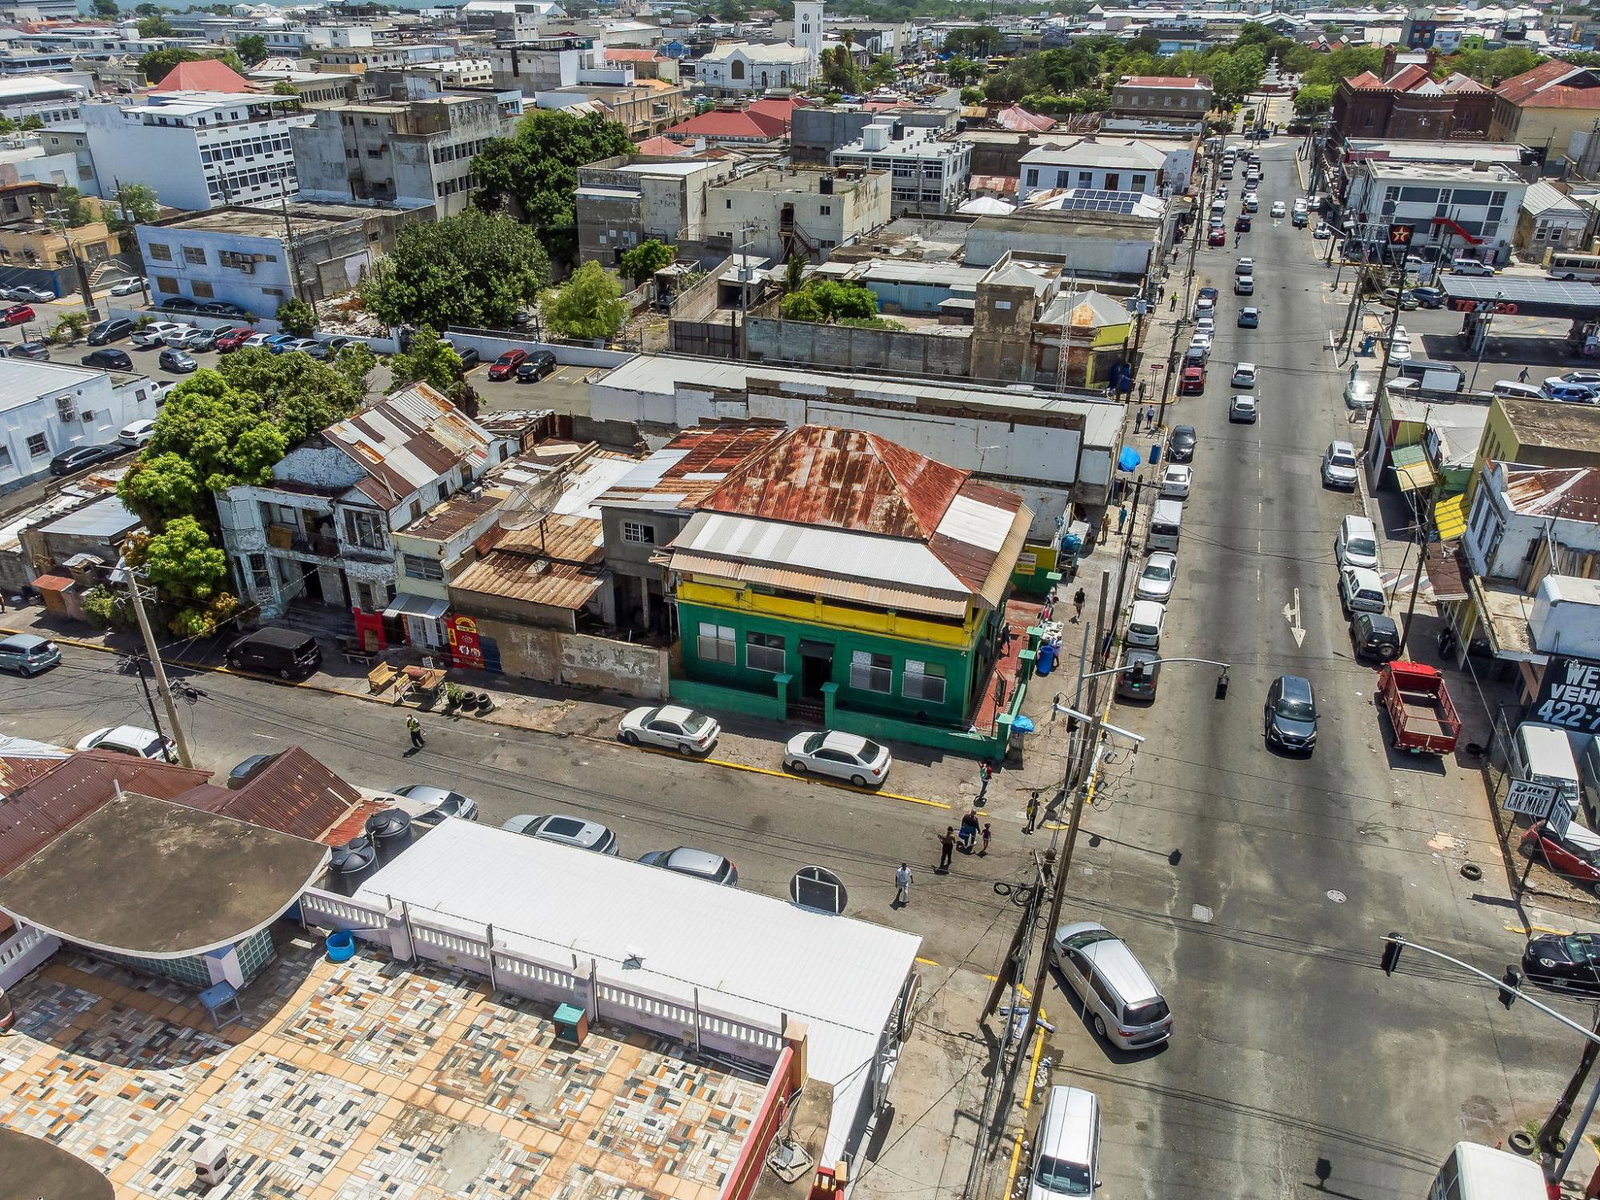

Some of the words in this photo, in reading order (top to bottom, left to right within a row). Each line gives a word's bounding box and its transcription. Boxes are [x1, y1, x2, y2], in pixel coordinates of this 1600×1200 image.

[1455, 299, 1518, 314] TEXACO
[1514, 783, 1550, 796] Drive
[1507, 792, 1526, 810] CAR
[1523, 795, 1549, 816] MART
